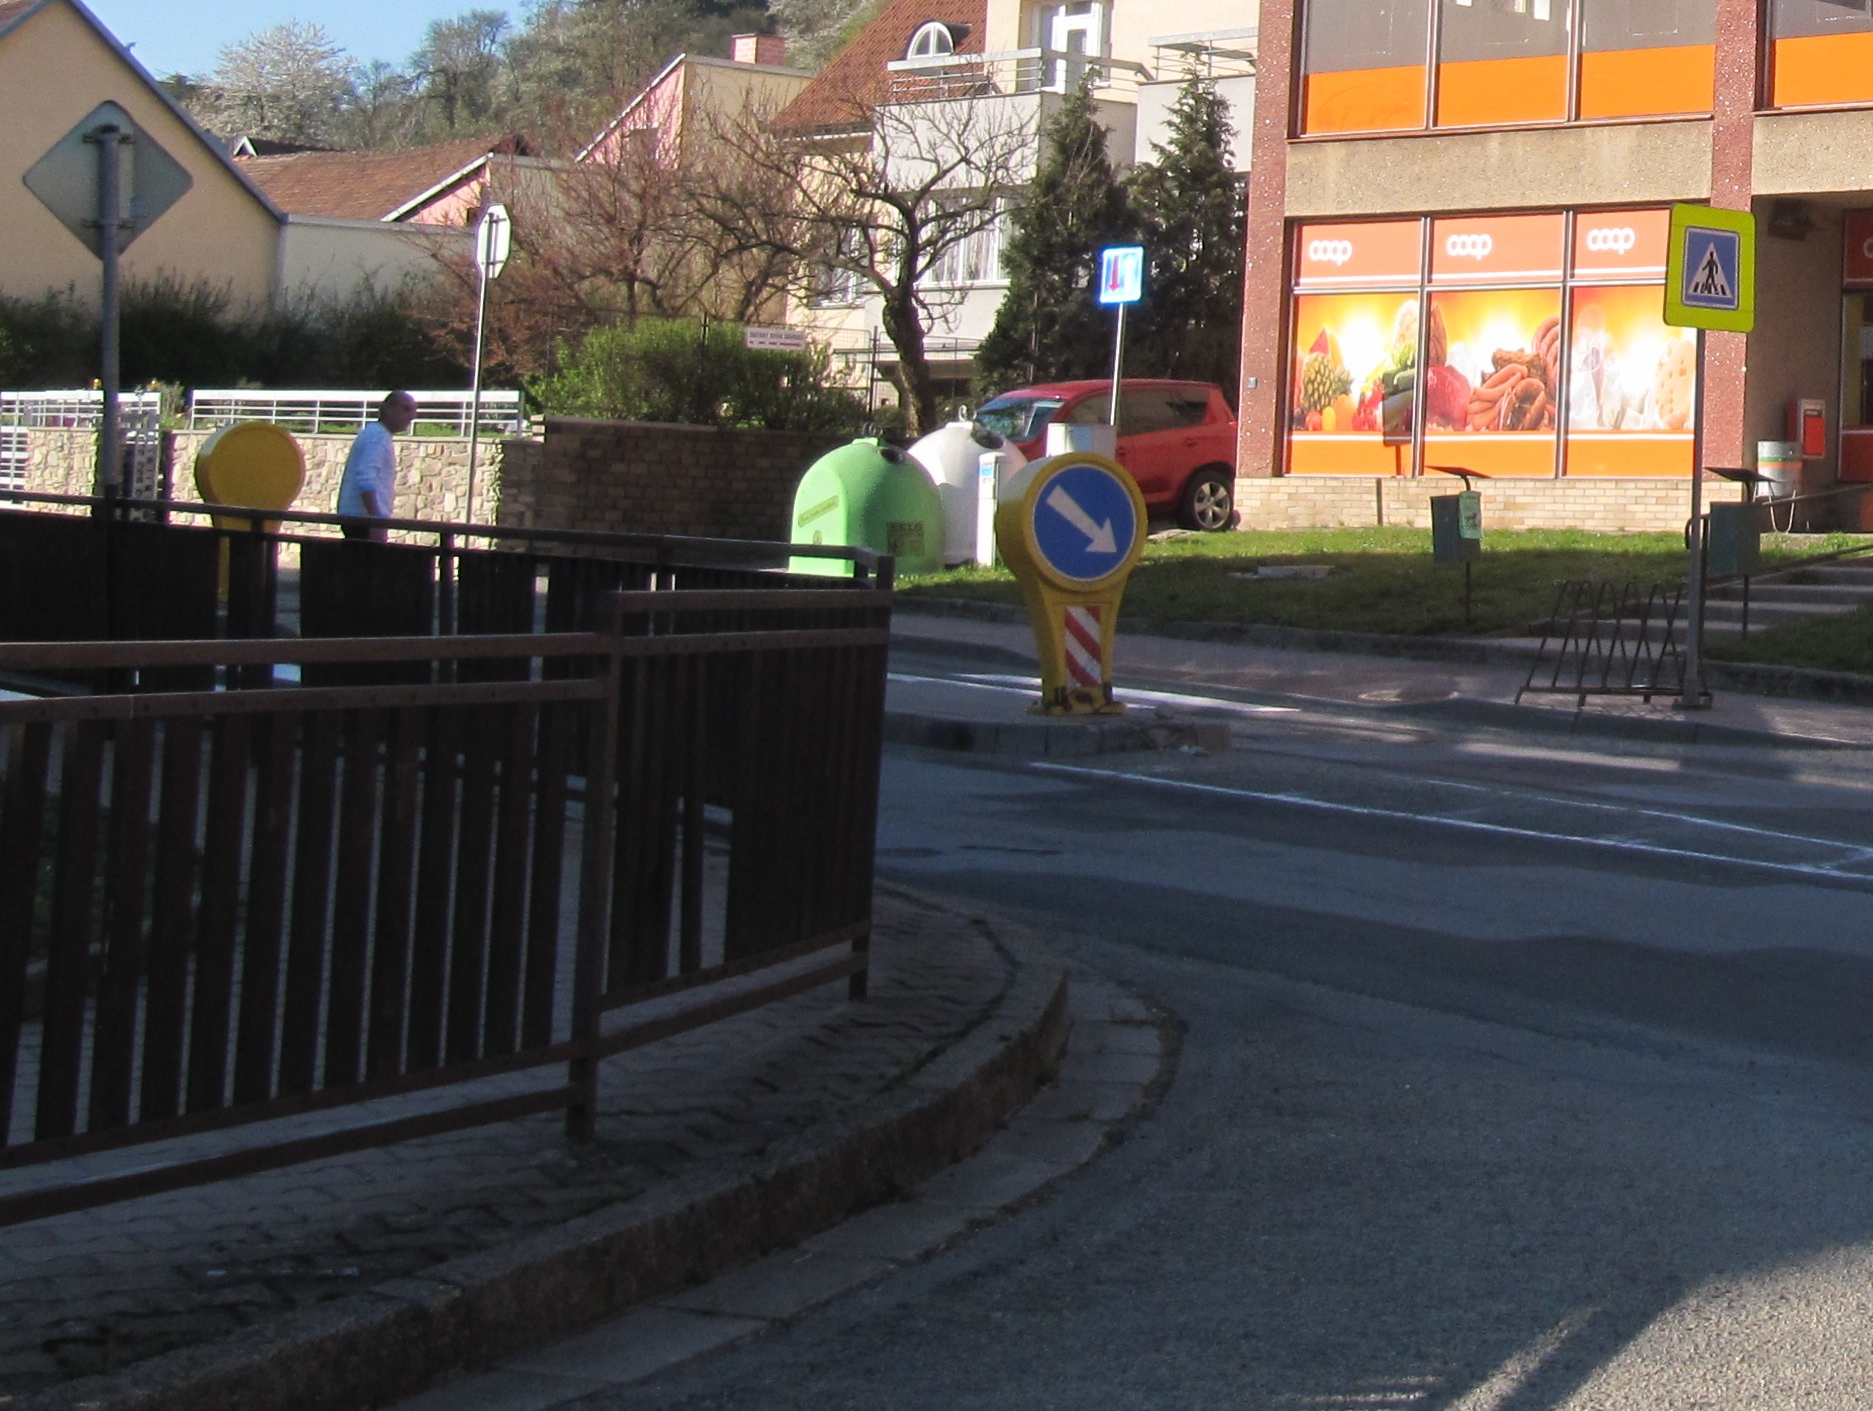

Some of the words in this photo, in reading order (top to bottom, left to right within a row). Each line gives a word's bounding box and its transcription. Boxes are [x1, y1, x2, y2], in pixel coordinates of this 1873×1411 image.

[1308, 239, 1352, 265] coop
[1446, 233, 1492, 260] coop
[1586, 227, 1635, 255] coop
